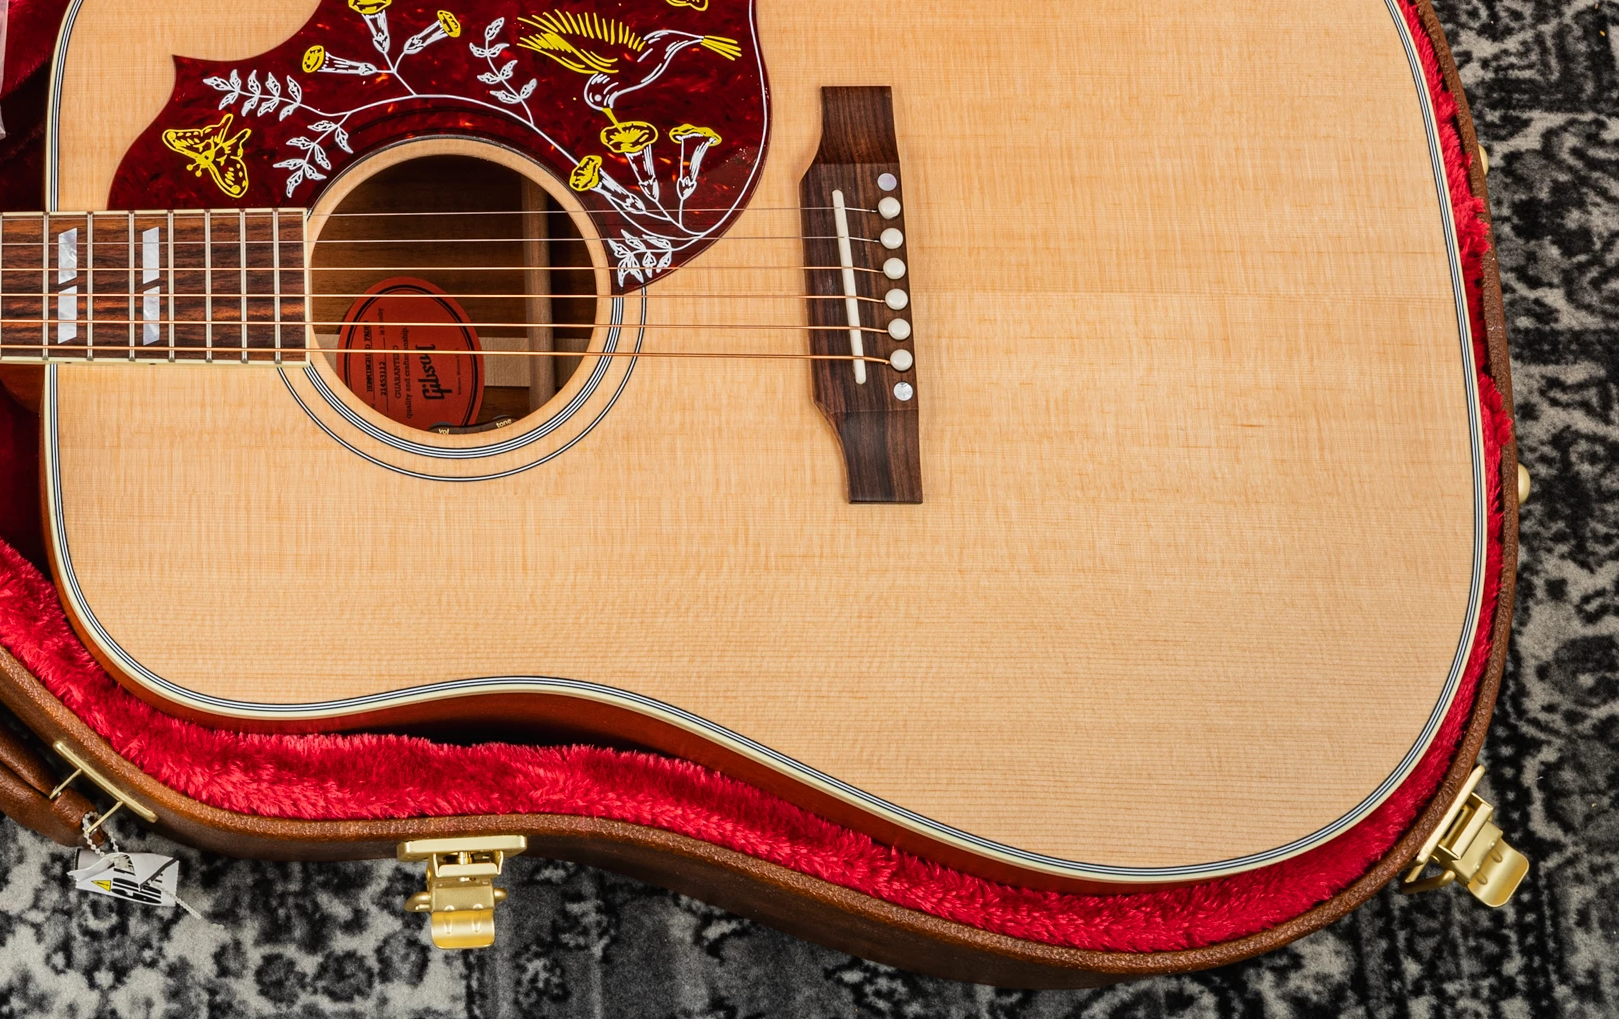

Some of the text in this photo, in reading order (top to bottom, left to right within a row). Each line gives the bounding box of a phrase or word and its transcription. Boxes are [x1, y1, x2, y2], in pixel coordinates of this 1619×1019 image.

[365, 343, 373, 392] HUMMINGBID
[393, 345, 401, 398] GUARANTED
[496, 418, 512, 428] tone
